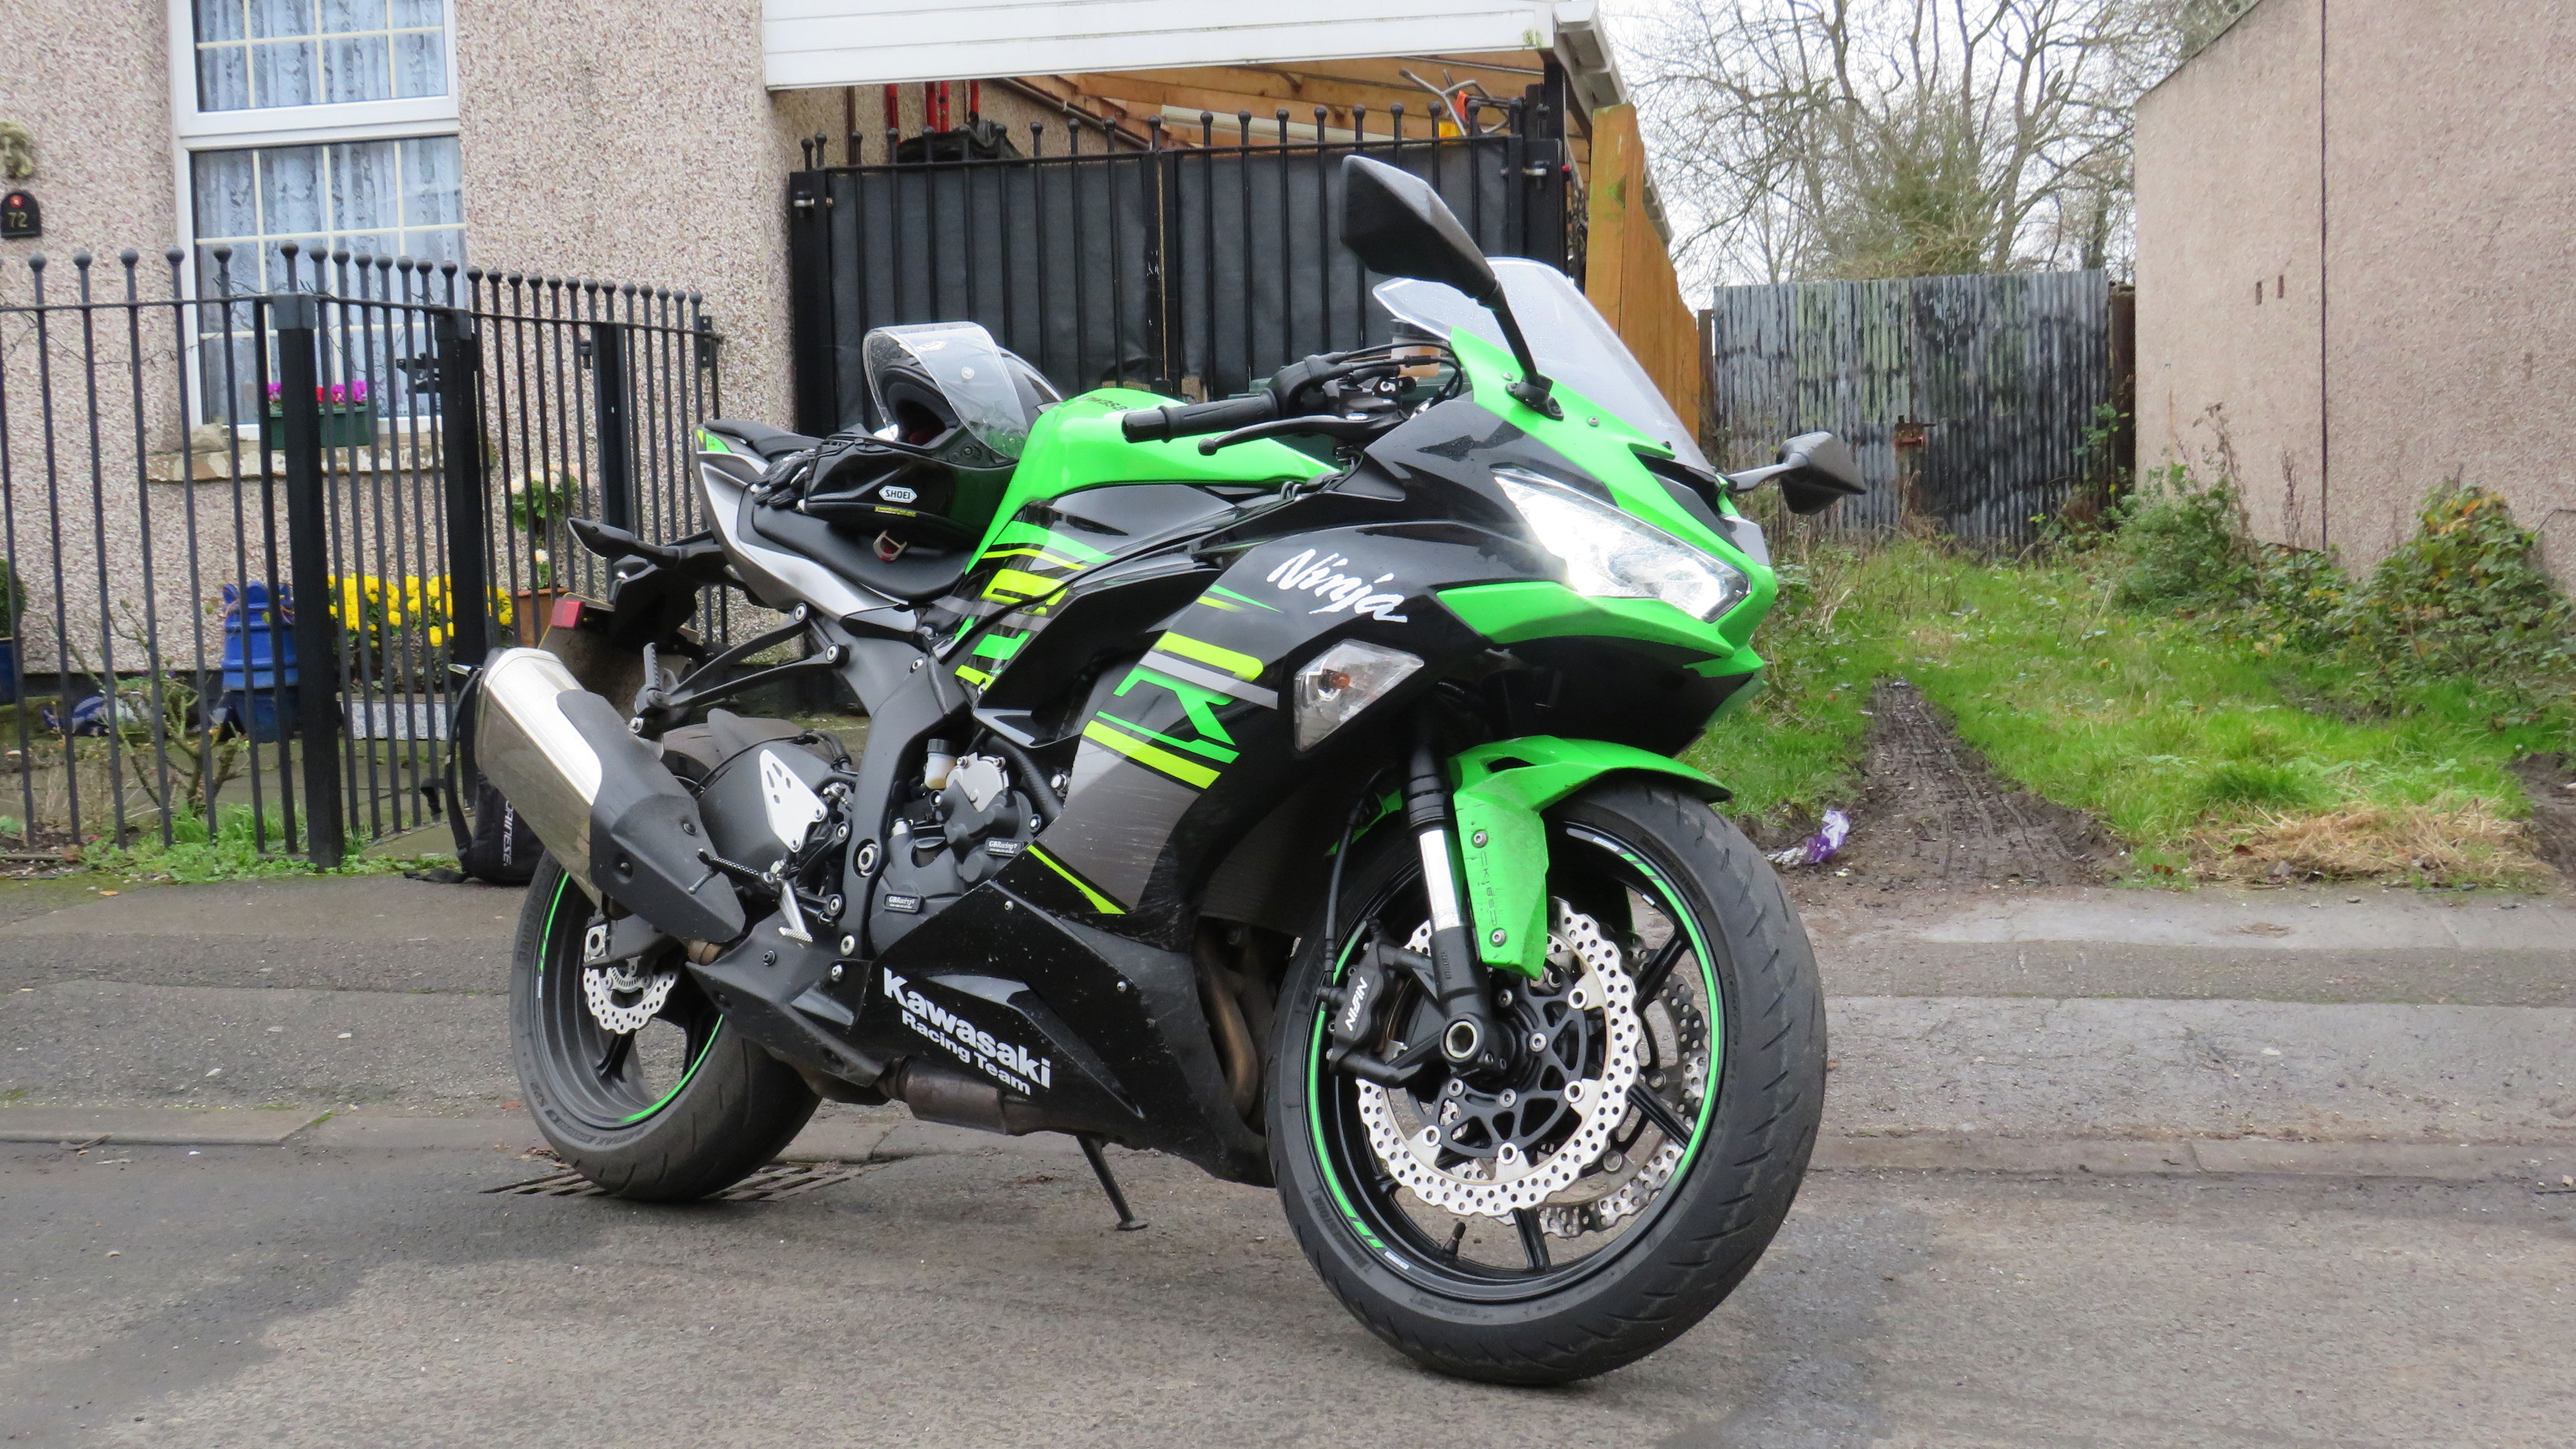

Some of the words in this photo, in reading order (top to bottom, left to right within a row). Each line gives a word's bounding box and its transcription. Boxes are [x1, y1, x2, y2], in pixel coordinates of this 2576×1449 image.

[8, 211, 27, 227] 72
[885, 489, 910, 500] SHOEI
[1267, 548, 1408, 623] Ninja
[884, 967, 1050, 1088] Kawasaki
[902, 1010, 970, 1063] Racing
[974, 1051, 1030, 1095] Team
